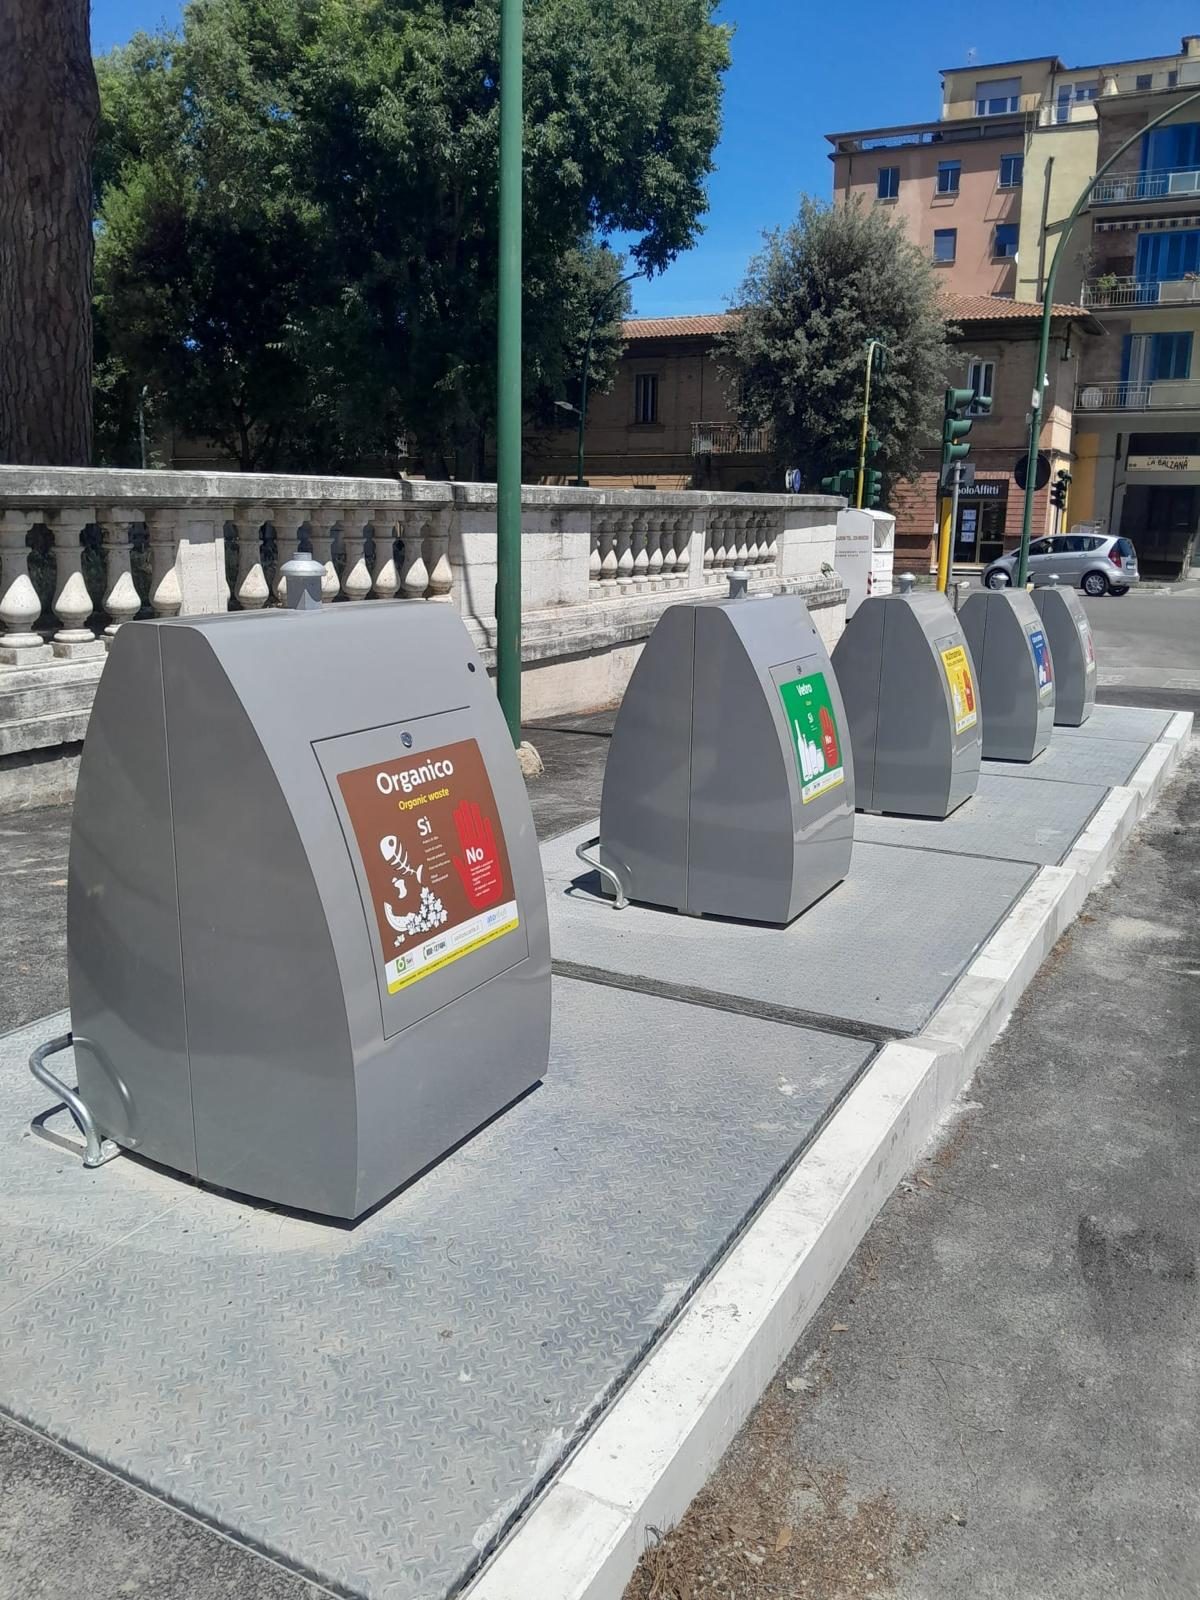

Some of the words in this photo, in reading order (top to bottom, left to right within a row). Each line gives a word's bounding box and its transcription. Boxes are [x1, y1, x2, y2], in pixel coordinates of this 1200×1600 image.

[796, 683, 813, 697] Vetro
[376, 759, 454, 795] Organico
[398, 797, 428, 811] Organic
[428, 787, 450, 802] waste
[465, 846, 484, 865] No
